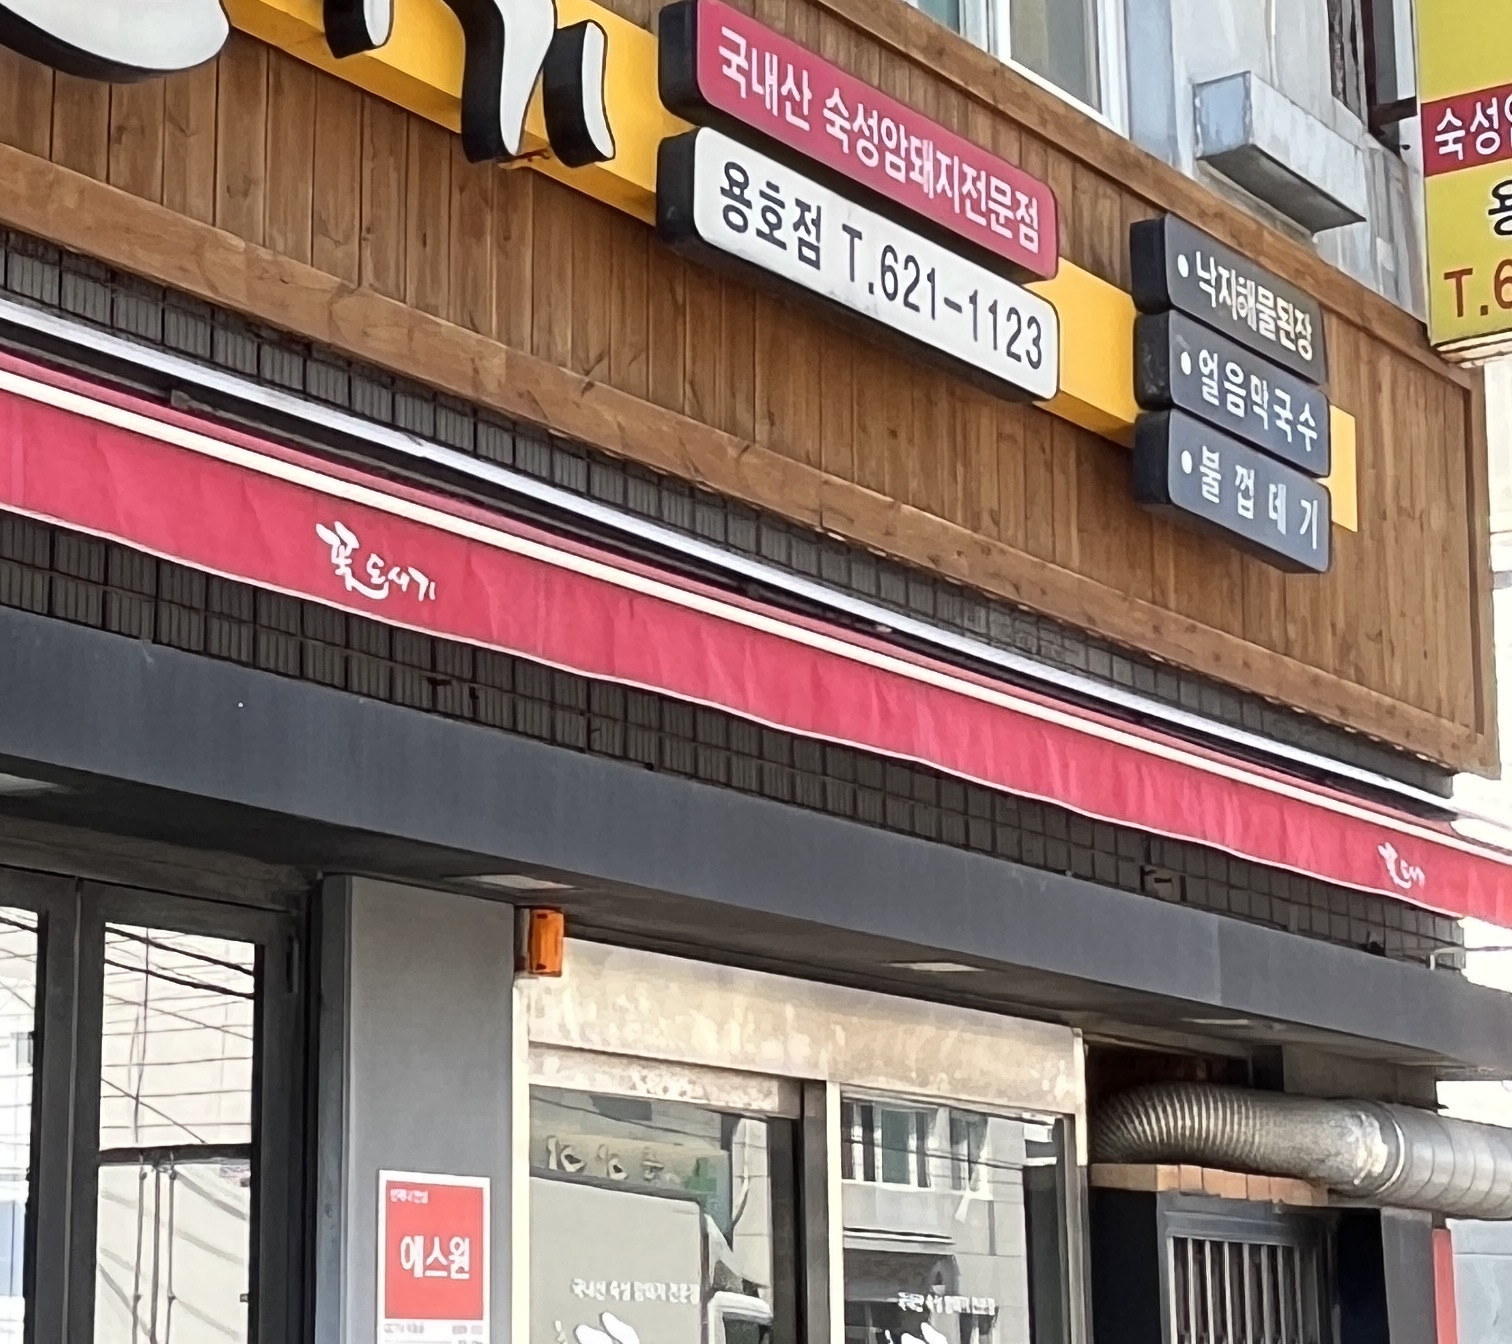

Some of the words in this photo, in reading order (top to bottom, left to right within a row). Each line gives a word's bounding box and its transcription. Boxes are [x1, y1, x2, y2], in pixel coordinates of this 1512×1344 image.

[718, 25, 813, 132] 국내산
[823, 87, 1040, 255] 숙성암돼지전문점
[1434, 94, 1512, 161] 숙성
[720, 161, 822, 271] 용호점
[842, 223, 1043, 370] T.621-1123
[1195, 251, 1314, 362] 낙지해물된장
[1198, 348, 1318, 453] 얼음막국수
[400, 1234, 470, 1280] 에스원
